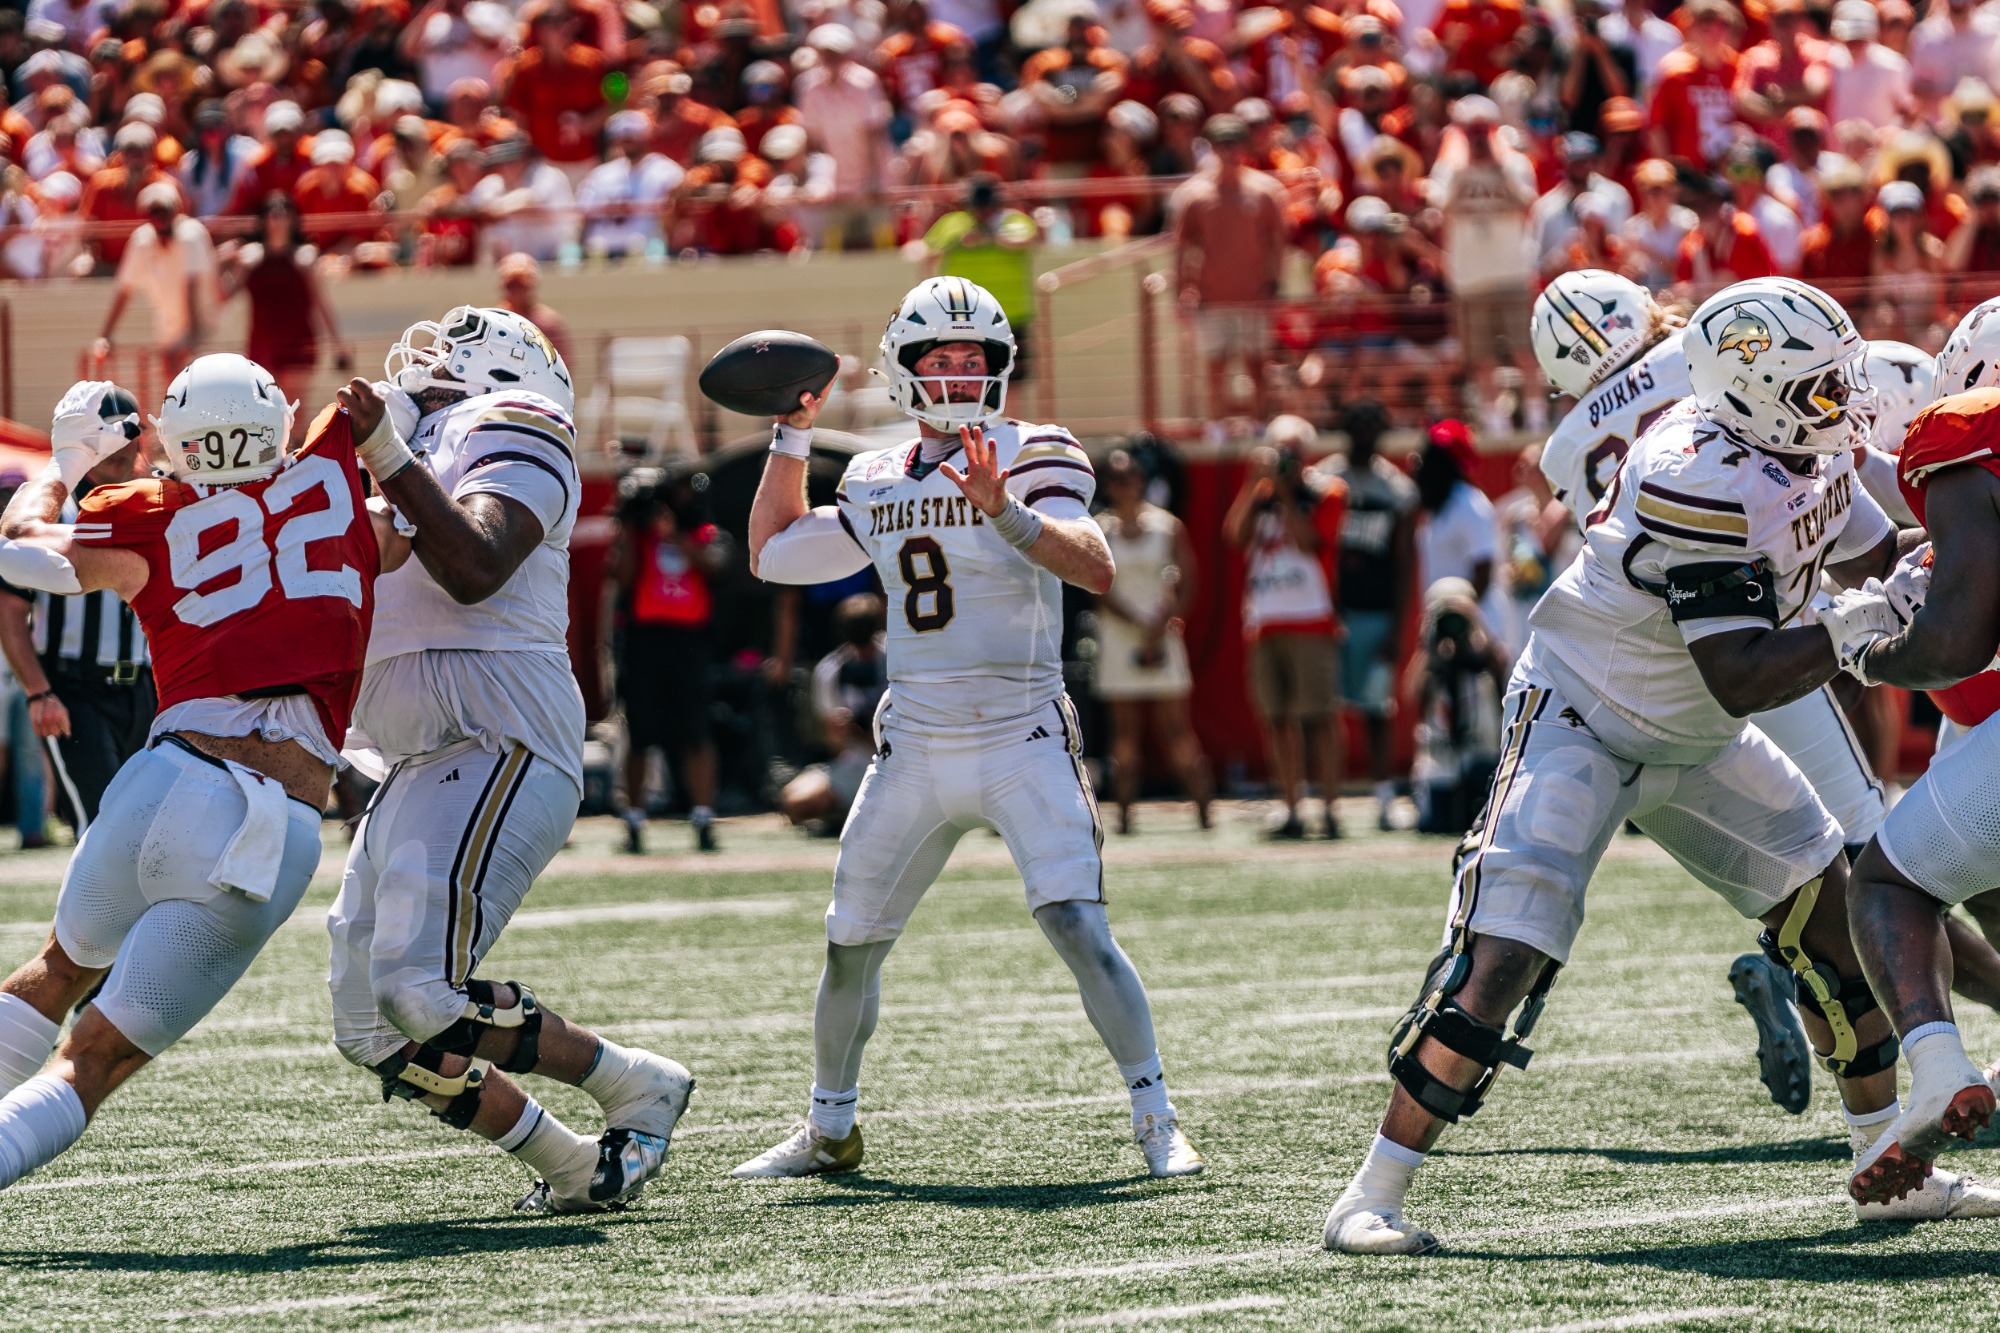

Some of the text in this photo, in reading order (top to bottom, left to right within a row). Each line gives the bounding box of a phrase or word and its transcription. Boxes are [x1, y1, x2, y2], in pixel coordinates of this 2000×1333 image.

[1588, 334, 1639, 384] TEXAS STATE
[1588, 362, 1655, 428] BURNS
[204, 427, 251, 470] 92
[1684, 428, 1752, 468] 77
[869, 495, 984, 537] TEXAS STATE
[164, 453, 363, 628] 92
[897, 534, 956, 635] 8
[1672, 590, 1696, 600] Douglas
